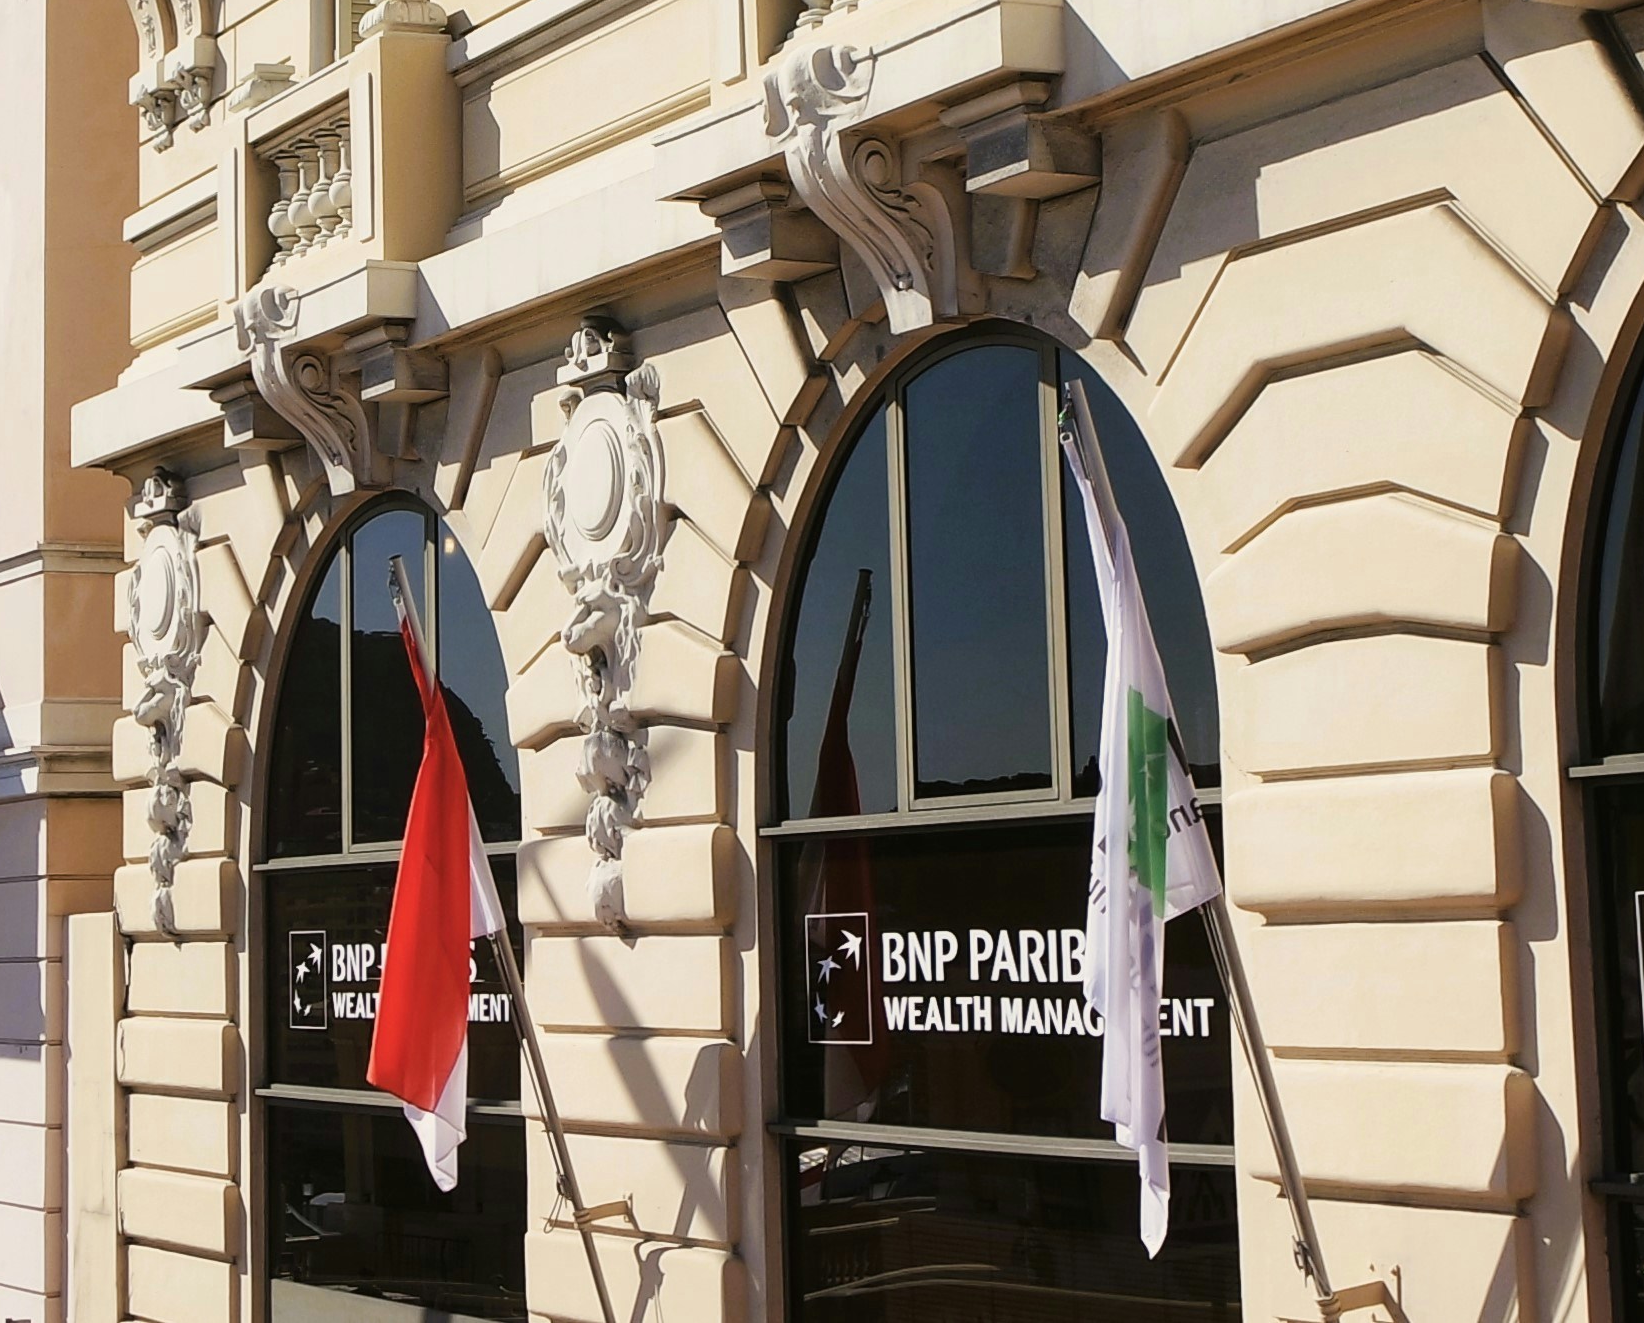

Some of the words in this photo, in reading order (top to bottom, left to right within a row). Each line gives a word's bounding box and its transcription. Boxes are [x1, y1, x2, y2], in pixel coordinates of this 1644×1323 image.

[331, 943, 375, 982] BNP
[881, 930, 959, 982] BNP
[969, 929, 1088, 983] PARIB
[331, 991, 379, 1019] WEALT
[883, 996, 992, 1032] WEALTH
[1000, 996, 1215, 1037] MANAGENT
